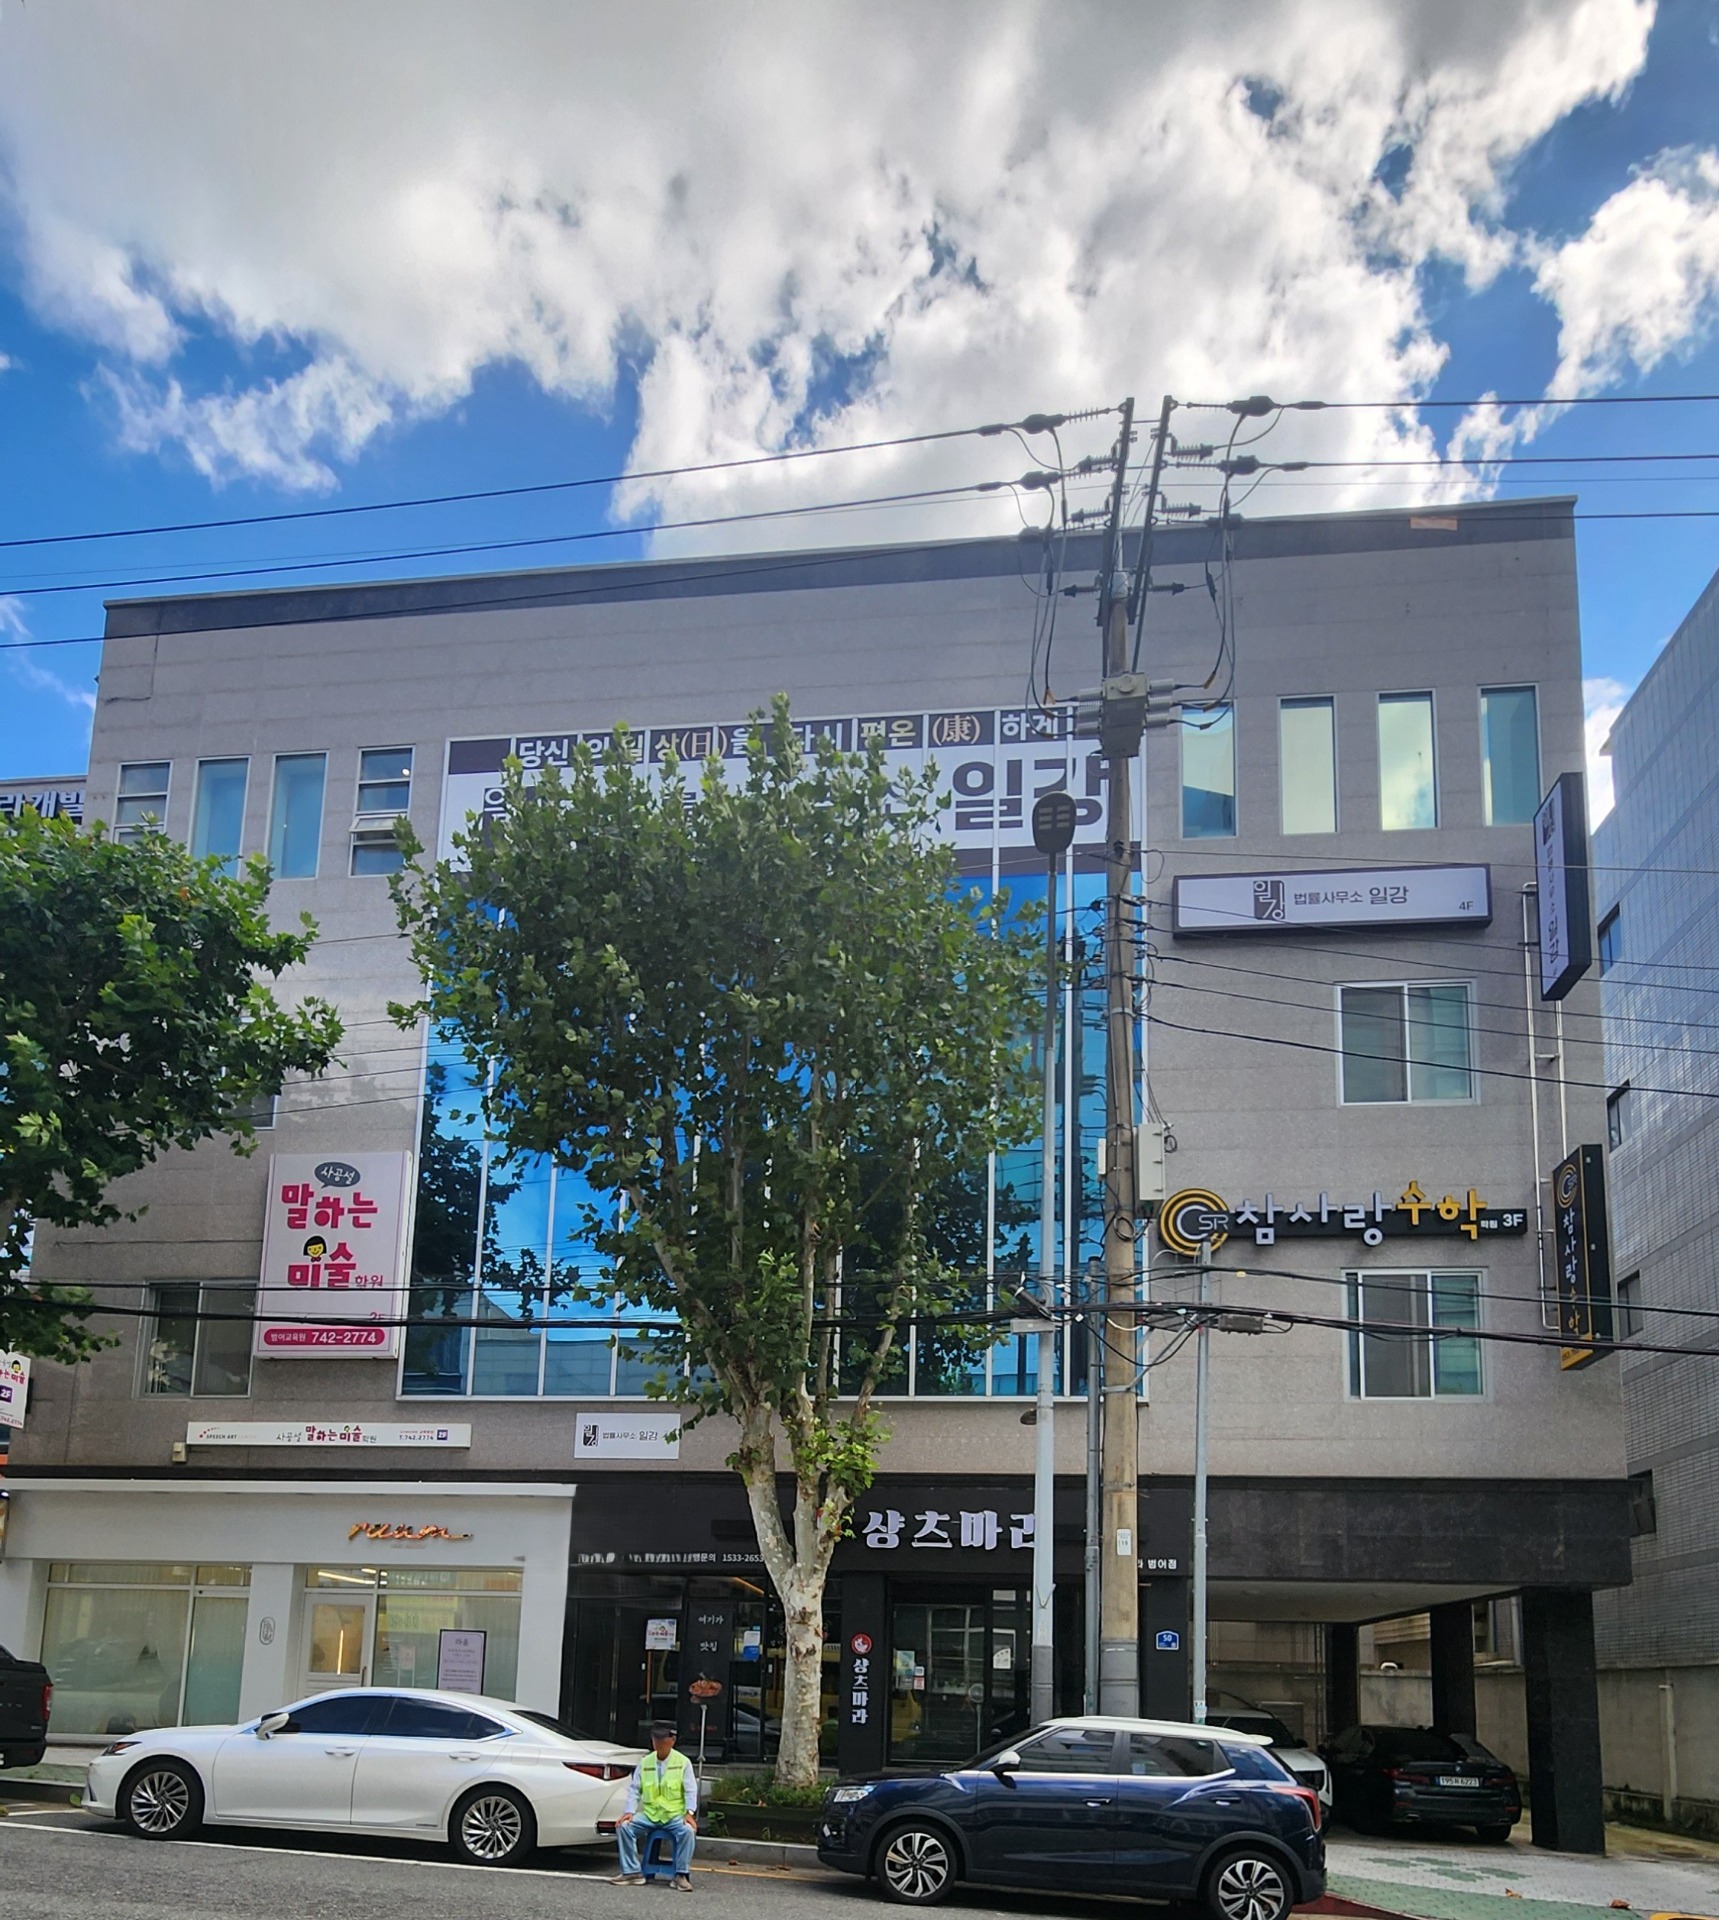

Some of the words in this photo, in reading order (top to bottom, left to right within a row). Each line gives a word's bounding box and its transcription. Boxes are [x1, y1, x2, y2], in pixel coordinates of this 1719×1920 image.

[1293, 891, 1363, 905] 법률사무소
[1369, 886, 1409, 905] 일강
[1459, 901, 1474, 911] 4F
[320, 1166, 355, 1185] 사공설
[281, 1183, 378, 1230] 말하는
[1502, 1213, 1524, 1227] 3F
[287, 1242, 357, 1288] 미술
[311, 1331, 377, 1344] 742-2774
[639, 1430, 658, 1441] 일강
[1147, 1559, 1178, 1570] 범어점
